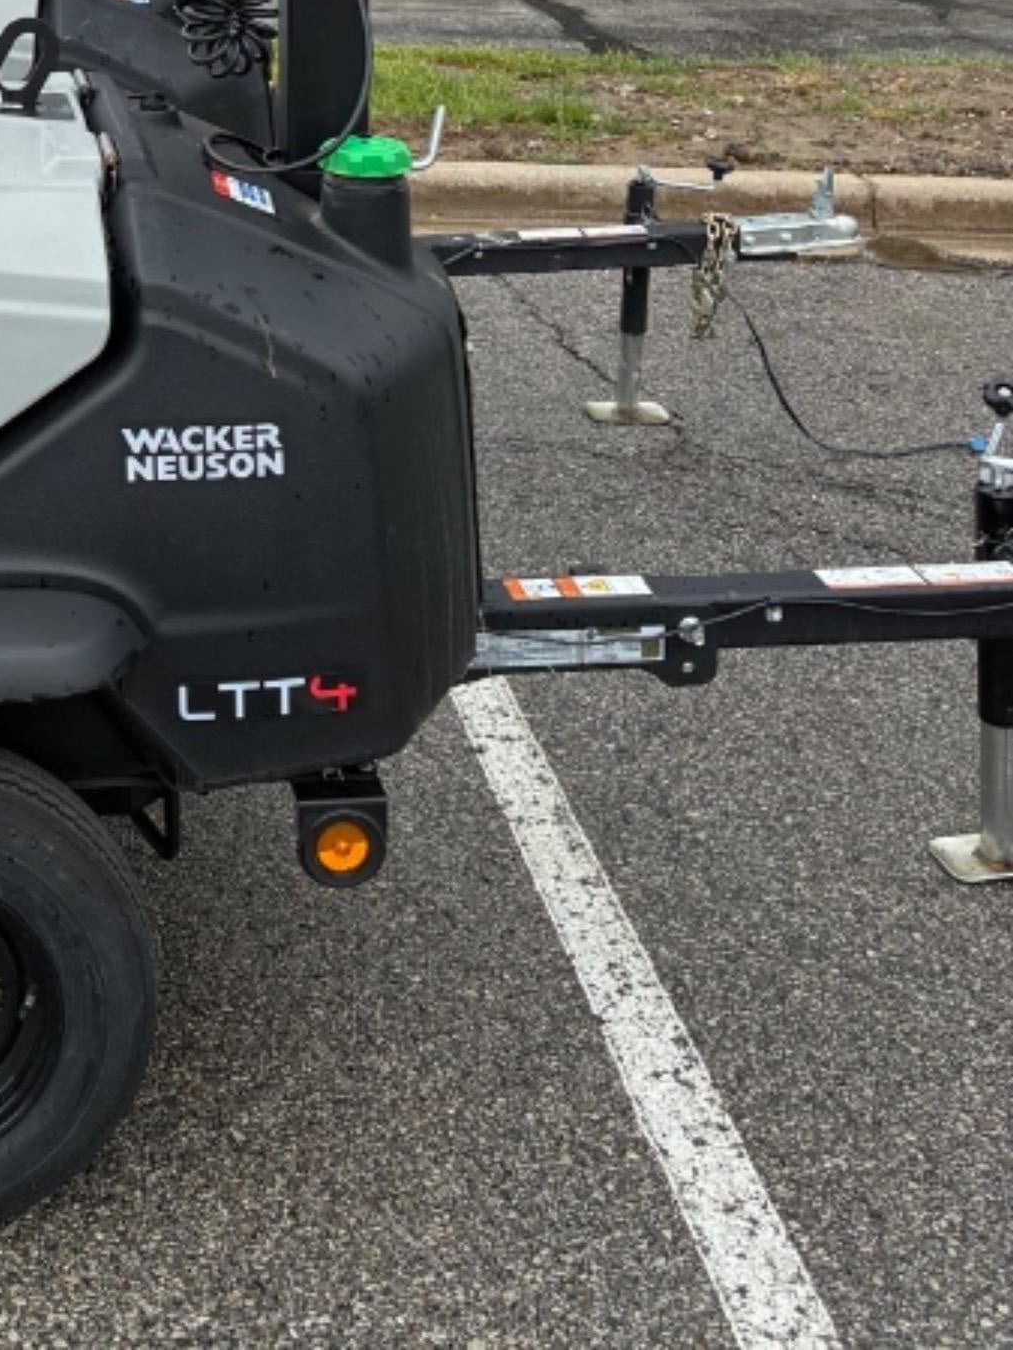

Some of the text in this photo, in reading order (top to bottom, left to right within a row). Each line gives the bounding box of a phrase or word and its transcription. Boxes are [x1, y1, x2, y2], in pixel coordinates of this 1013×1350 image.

[122, 423, 282, 453] WACKER
[126, 451, 285, 483] NEUSON
[178, 676, 356, 721] LTT4
